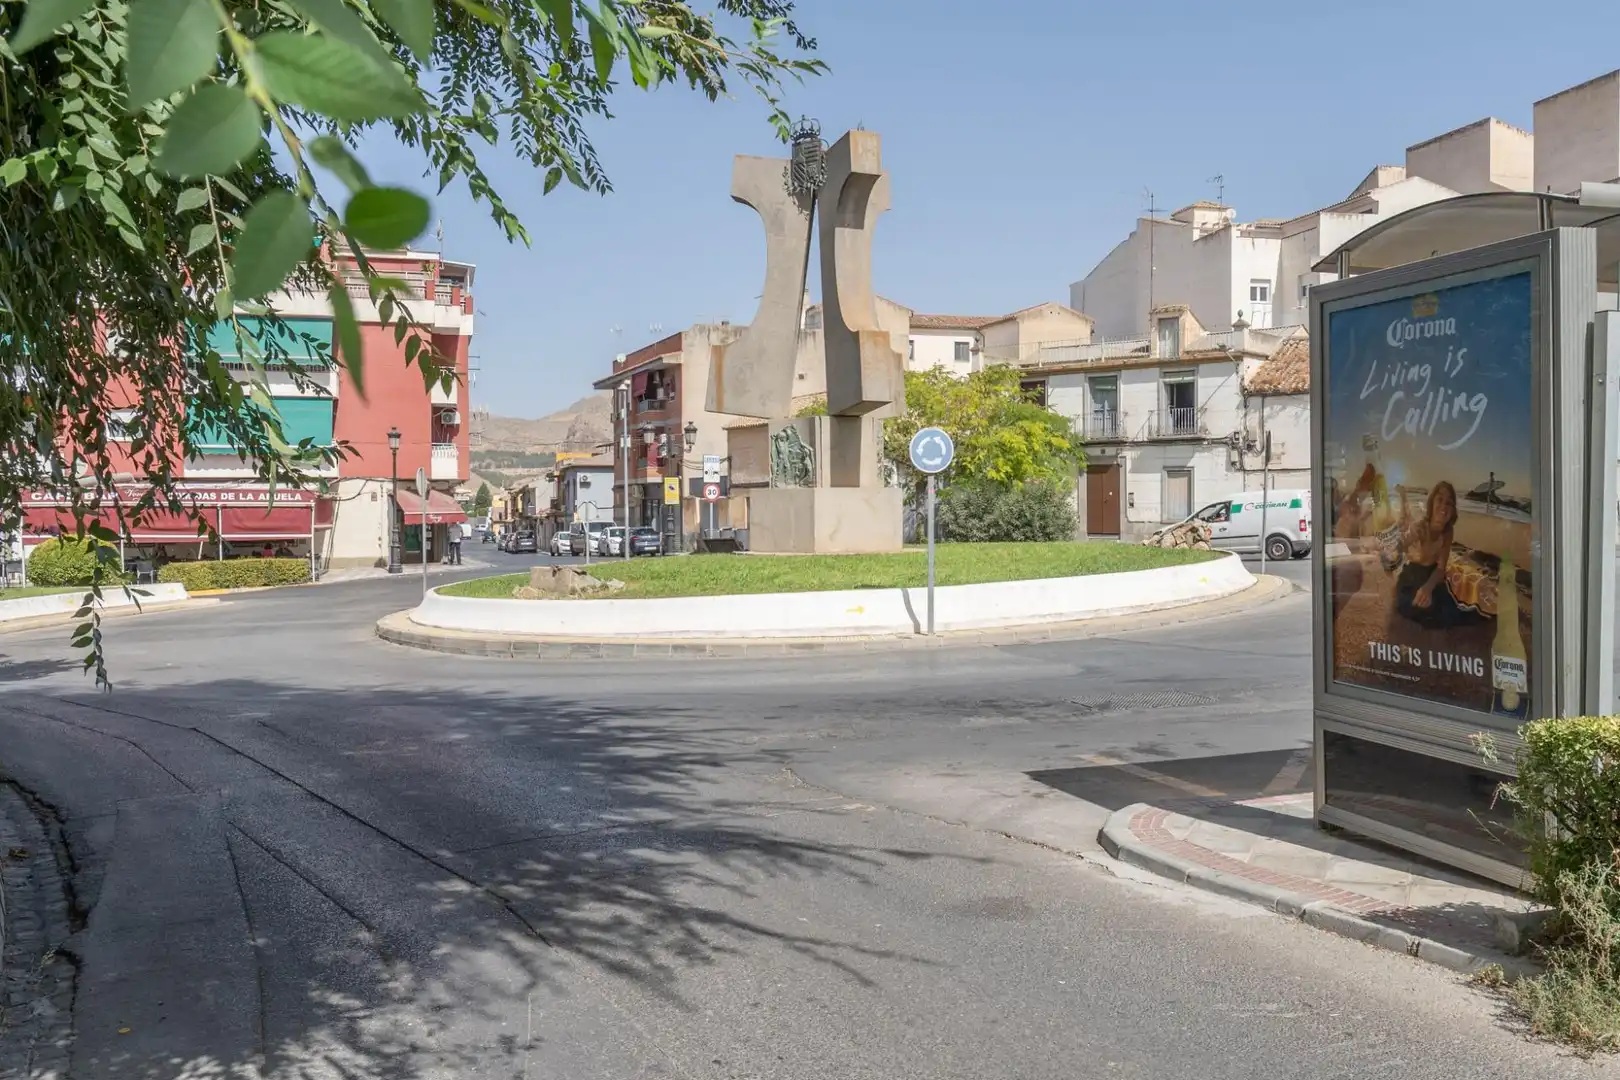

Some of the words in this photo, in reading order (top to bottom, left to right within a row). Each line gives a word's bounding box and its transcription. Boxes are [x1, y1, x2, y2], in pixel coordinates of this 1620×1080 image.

[1386, 317, 1456, 348] Corona
[1359, 359, 1431, 400] Living
[1444, 345, 1468, 378] is
[1381, 386, 1488, 451] Calling
[220, 492, 235, 500] DE
[239, 492, 254, 500] LA
[258, 492, 302, 500] AUELA
[707, 488, 717, 496] 30
[1367, 641, 1401, 664] THIS
[1408, 647, 1422, 667] IS
[1428, 650, 1484, 677] LIVING
[1494, 658, 1525, 674] Corona
